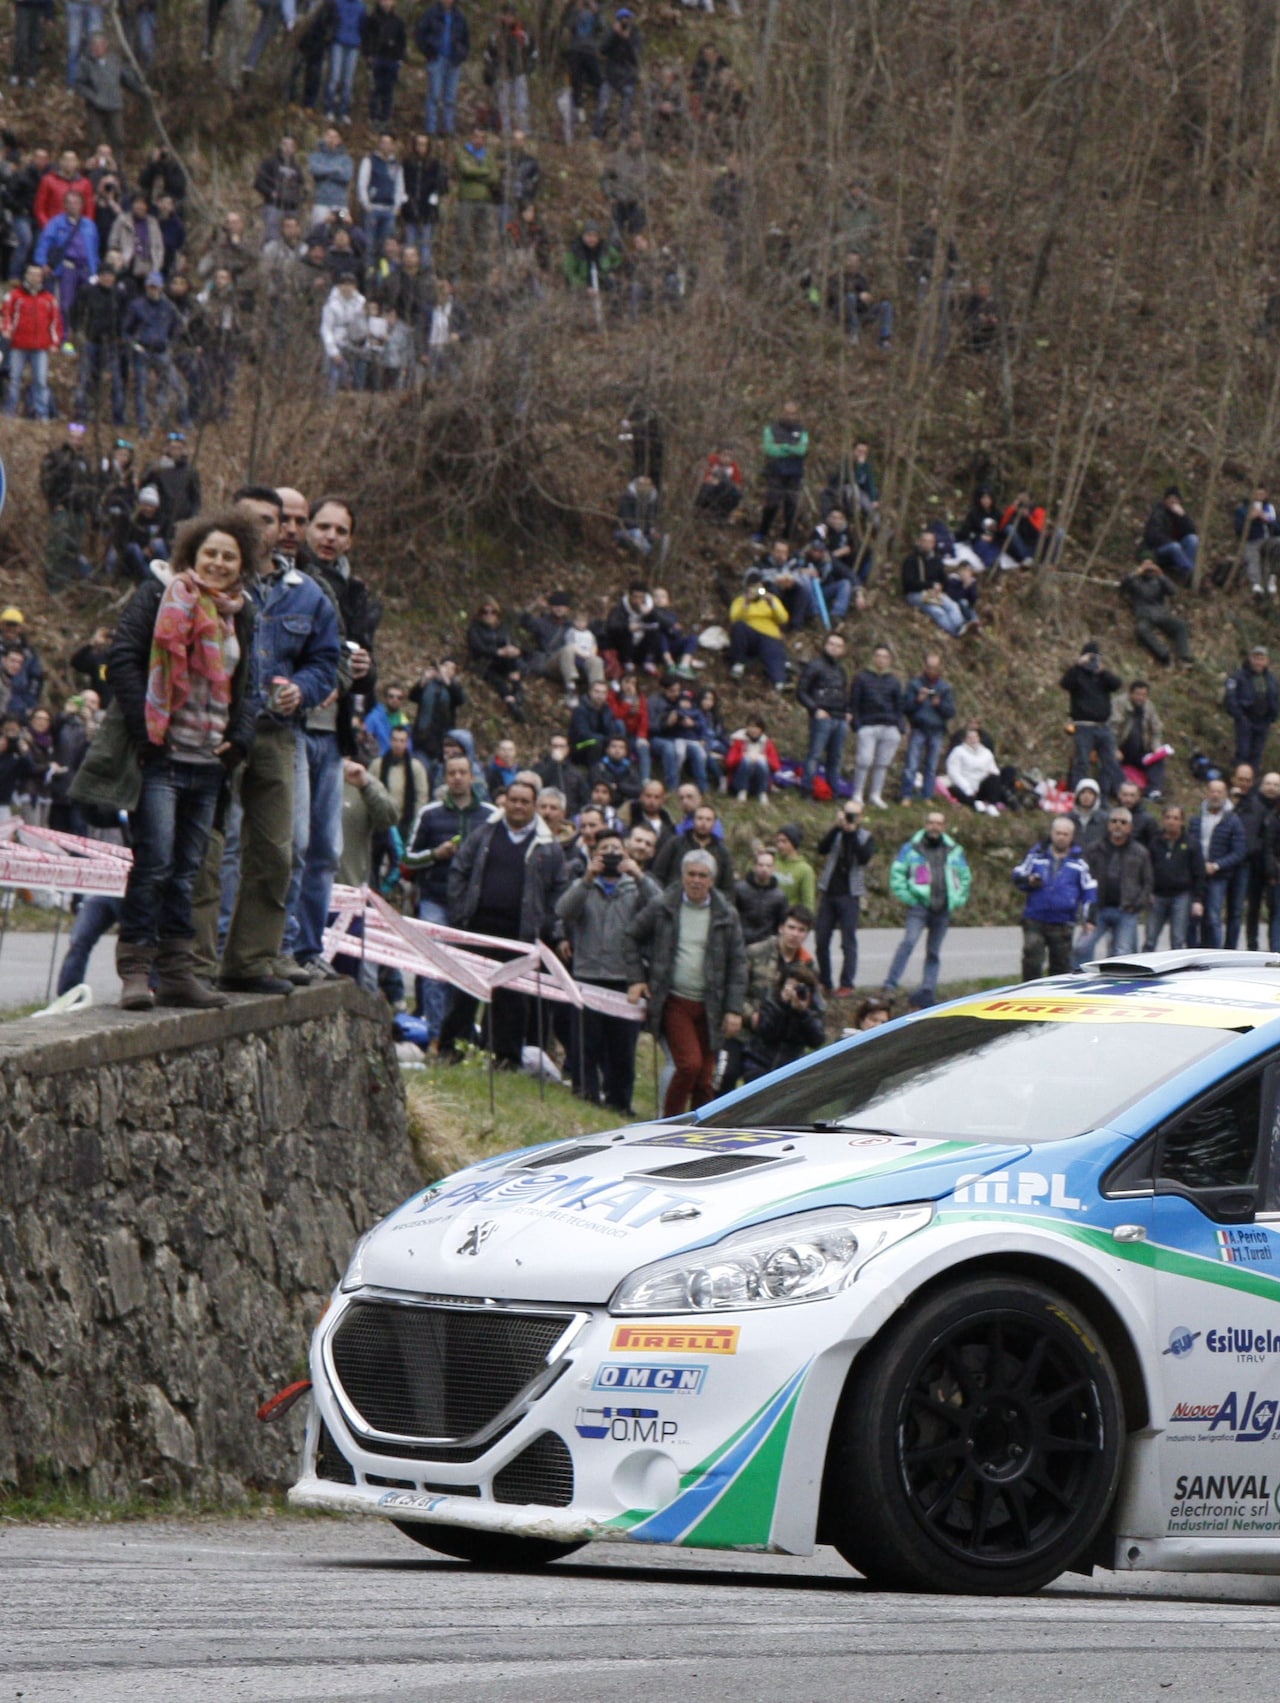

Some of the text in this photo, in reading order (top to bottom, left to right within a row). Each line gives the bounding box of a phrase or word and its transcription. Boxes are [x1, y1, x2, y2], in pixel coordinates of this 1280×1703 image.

[982, 1001, 1175, 1018] PIRELLI
[1229, 1230, 1269, 1244] A.Perico
[1232, 1245, 1273, 1261] M.Turati
[615, 1328, 735, 1349] PIRELLI
[1237, 1354, 1266, 1363] ITALY
[599, 1366, 700, 1389] OMCN
[1171, 1402, 1220, 1417] Nuova
[1174, 1475, 1270, 1500] SANVAL
[1170, 1500, 1269, 1517] electronic srl
[1168, 1519, 1228, 1531] Industrial
